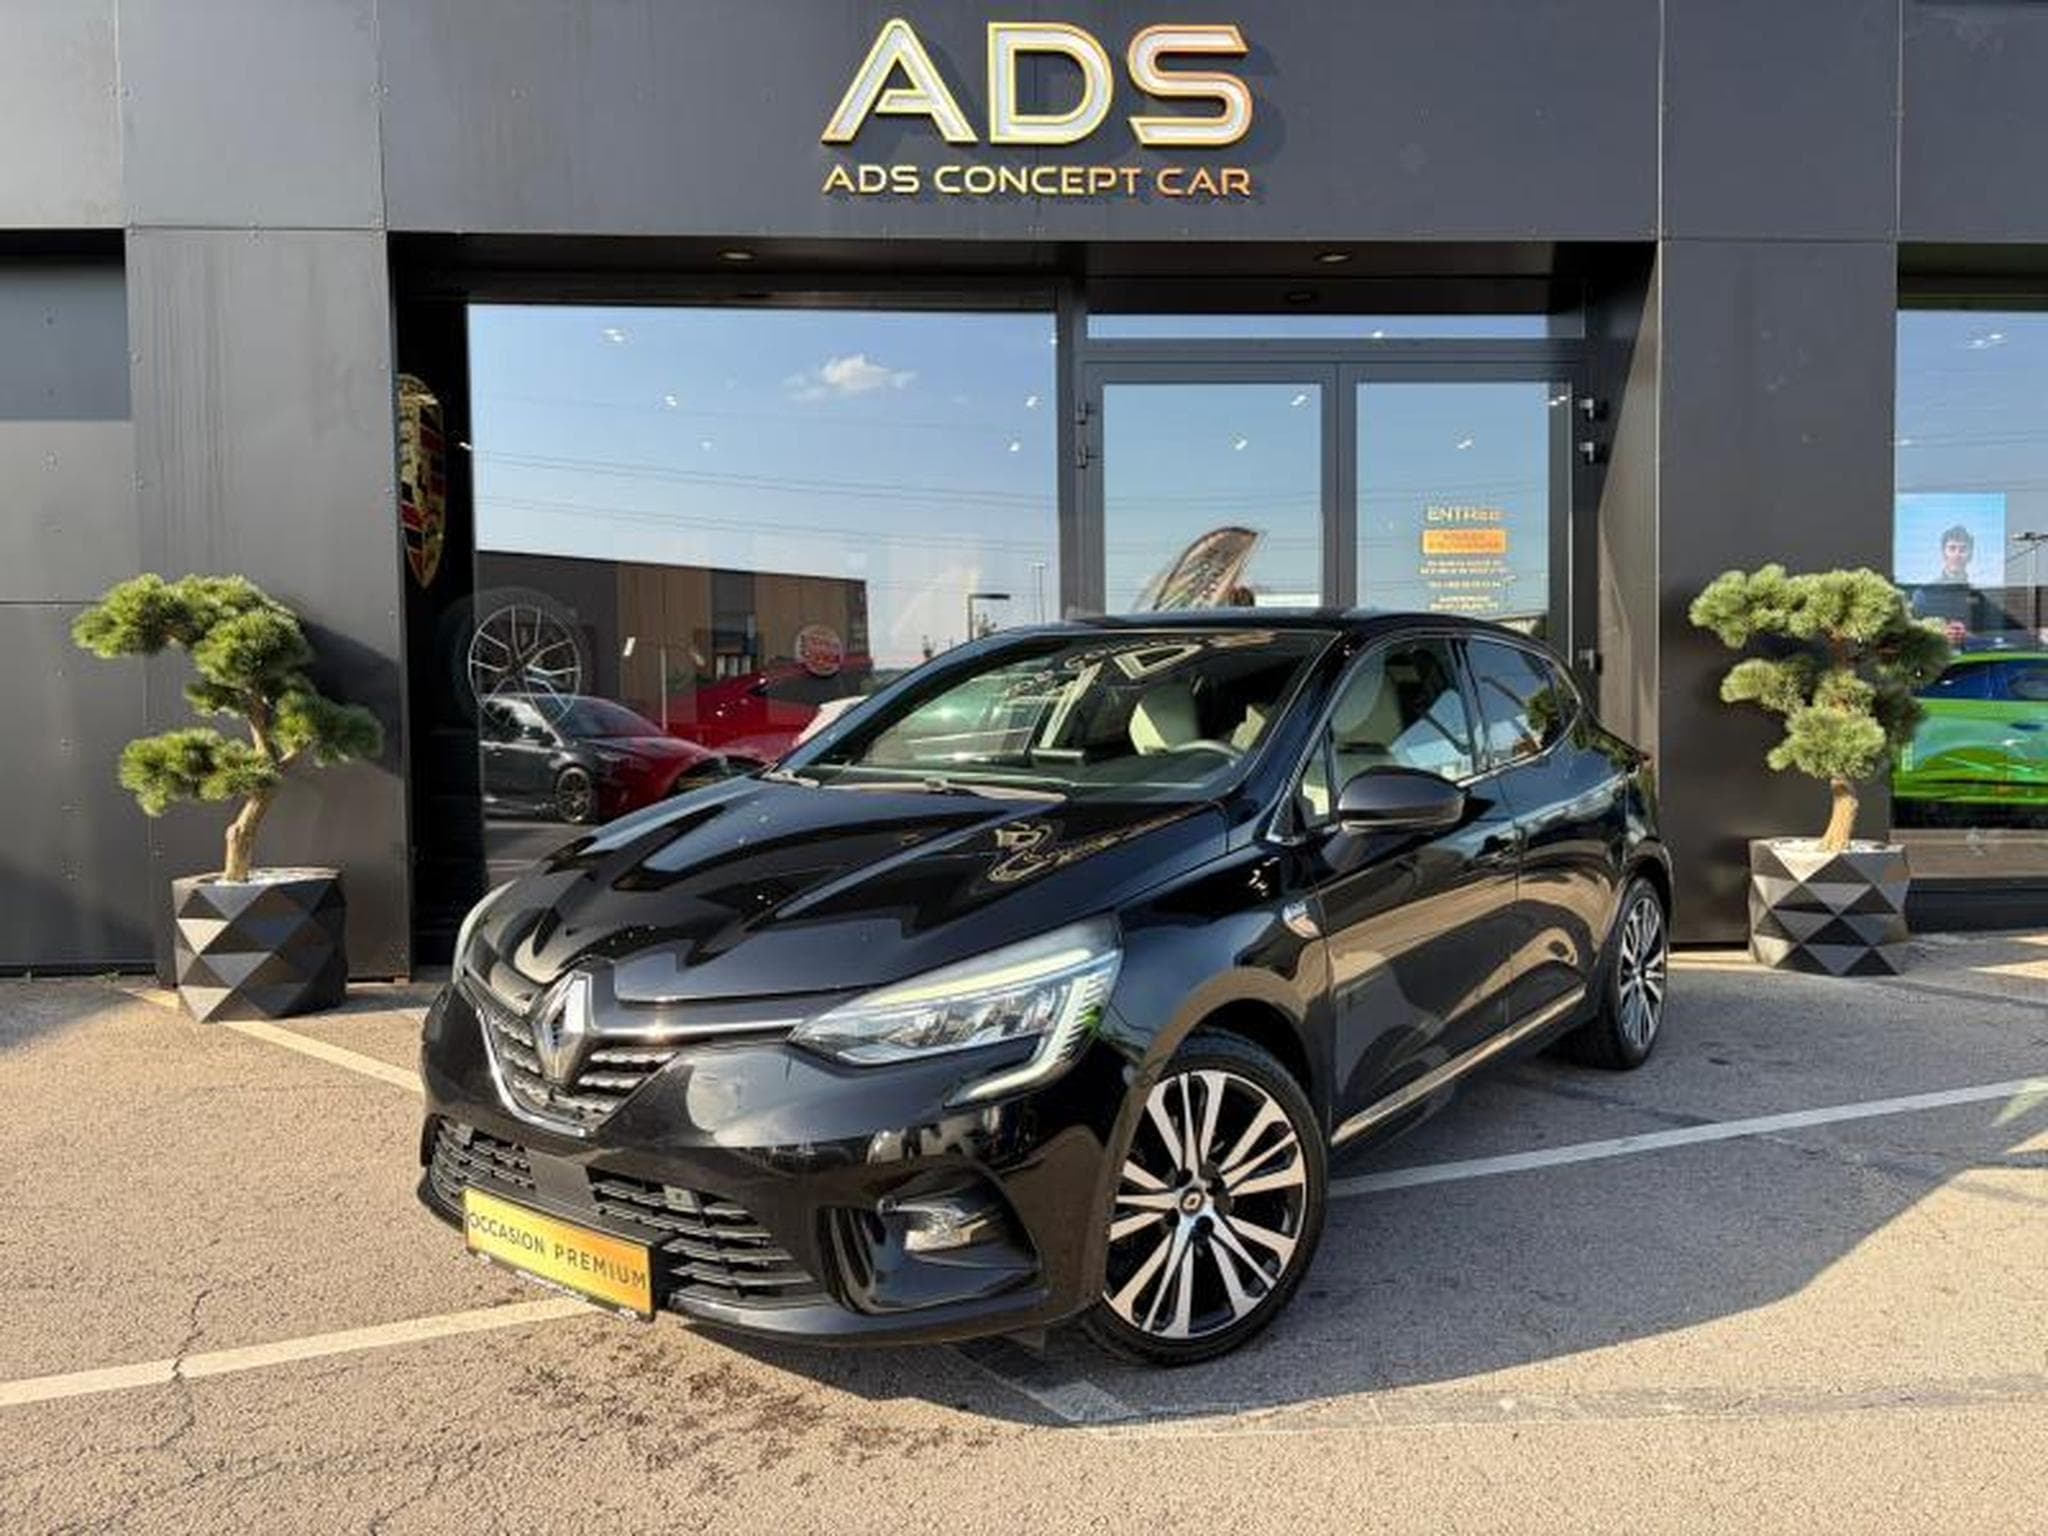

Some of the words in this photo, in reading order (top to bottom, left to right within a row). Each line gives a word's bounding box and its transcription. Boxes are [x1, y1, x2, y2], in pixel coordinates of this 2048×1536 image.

[821, 18, 1253, 145] ADS
[823, 165, 920, 194] ADS
[934, 165, 1142, 196] CONCEPT
[1157, 168, 1251, 196] CAR
[467, 1211, 545, 1257] OCCASION
[554, 1243, 646, 1290] PREMIUM
